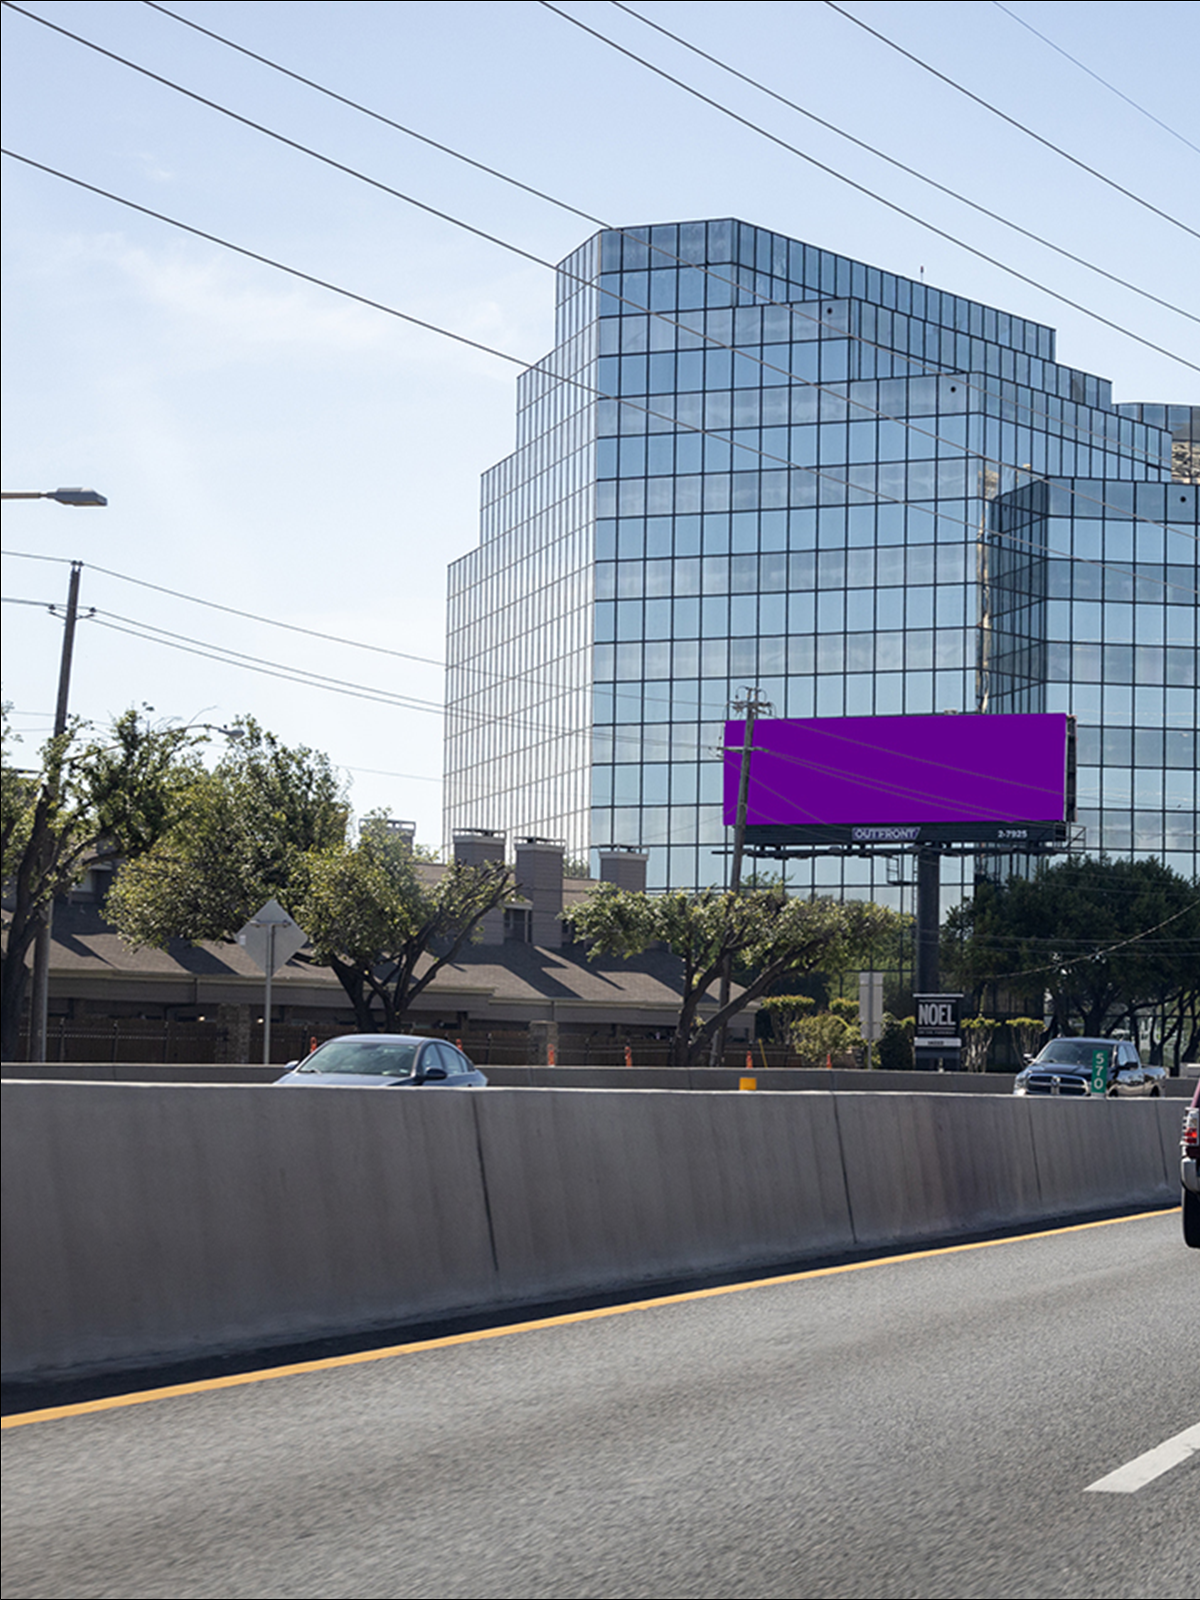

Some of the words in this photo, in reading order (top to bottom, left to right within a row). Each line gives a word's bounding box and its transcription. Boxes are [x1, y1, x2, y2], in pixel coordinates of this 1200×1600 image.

[854, 828, 916, 839] OUTFRONT
[998, 829, 1028, 839] 2-7925
[918, 1003, 957, 1026] NOEL
